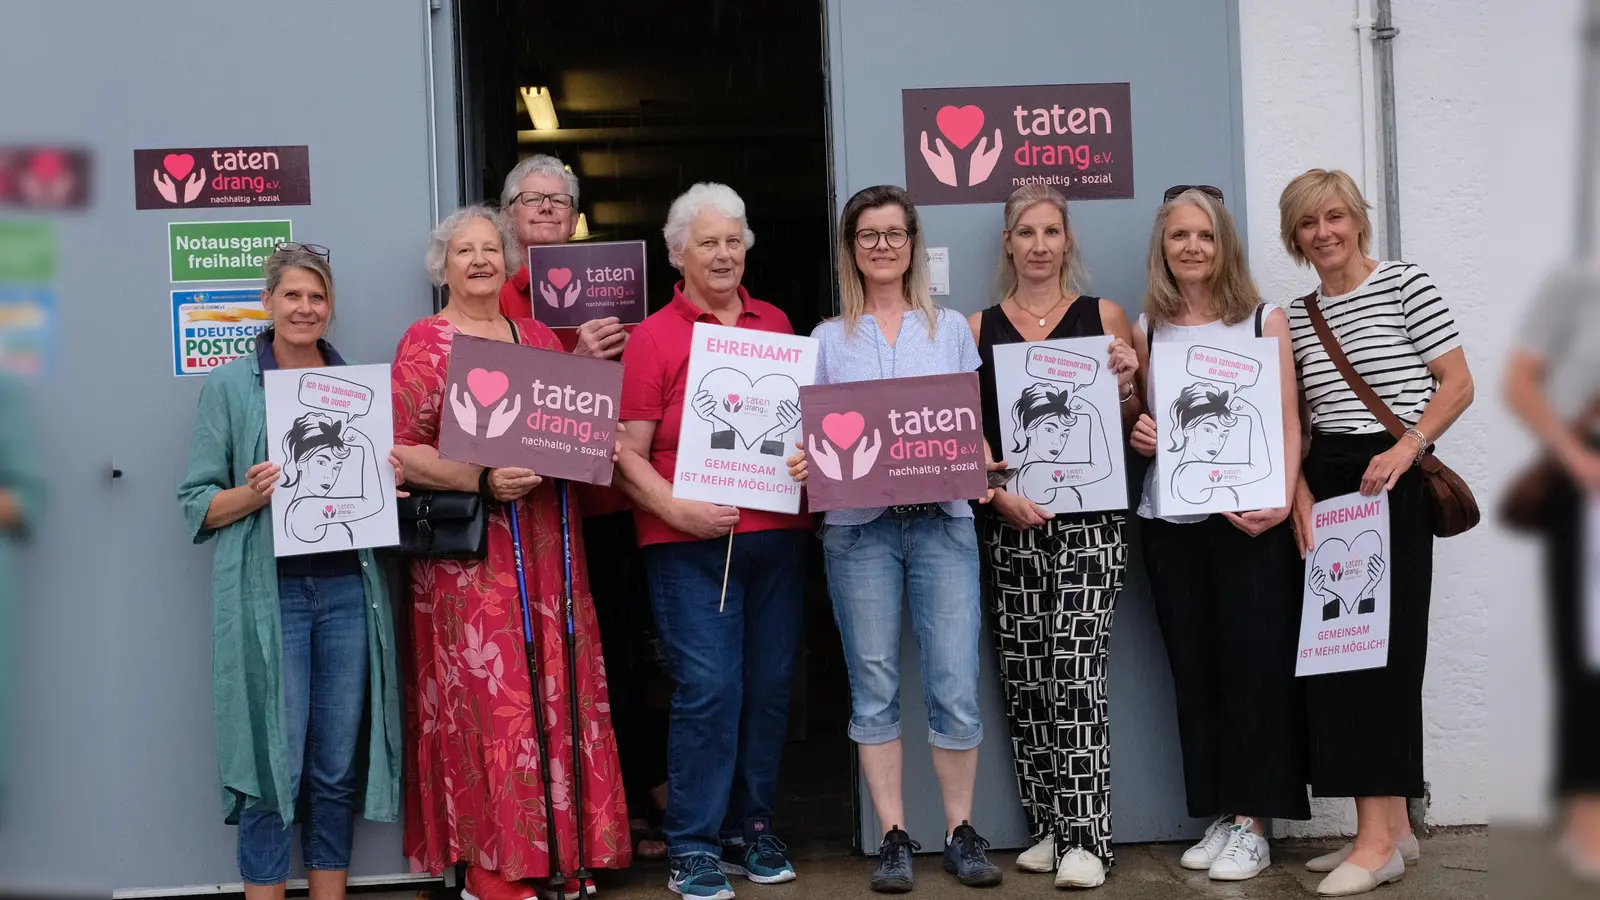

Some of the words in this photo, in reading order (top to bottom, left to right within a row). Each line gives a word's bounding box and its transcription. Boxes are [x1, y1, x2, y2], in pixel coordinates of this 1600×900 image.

[1014, 104, 1112, 136] taten
[212, 150, 280, 171] taten
[1014, 140, 1090, 170] drang
[1094, 152, 1114, 164] e.V.
[212, 174, 265, 193] drang
[1012, 174, 1070, 187] nachhaltig
[1082, 173, 1112, 184] sozial
[210, 196, 250, 204] nachhaltig
[258, 194, 280, 202] sozial
[176, 236, 288, 252] Notausgang
[586, 266, 634, 282] taten
[586, 286, 624, 298] drang
[586, 300, 615, 308] nachhaltig
[706, 337, 803, 364] EHRENAMT
[1048, 367, 1056, 375] du
[1057, 370, 1077, 378] auch?
[1218, 370, 1238, 380] auch?
[320, 396, 330, 404] du
[330, 398, 351, 408] auch?
[532, 379, 614, 419] taten
[526, 408, 592, 444] drang
[594, 430, 610, 442] e.V.
[888, 406, 976, 436] taten
[522, 436, 571, 454] nachhaltig
[580, 446, 608, 458] sozial
[890, 436, 958, 460] drang
[960, 444, 979, 455] e.V.
[704, 458, 776, 476] GEMEINSAM
[888, 464, 941, 477] nachhaltig
[950, 461, 979, 472] sozial
[680, 472, 700, 482] IST
[700, 474, 734, 488] MEHR
[738, 478, 797, 495] MÖGLICH!
[1316, 500, 1381, 528] EHRENAMT
[1318, 624, 1370, 641] GEMEINSAM
[1300, 648, 1314, 659] IST
[1314, 644, 1340, 657] MEHR
[1342, 638, 1386, 654] MÖGLICH!
